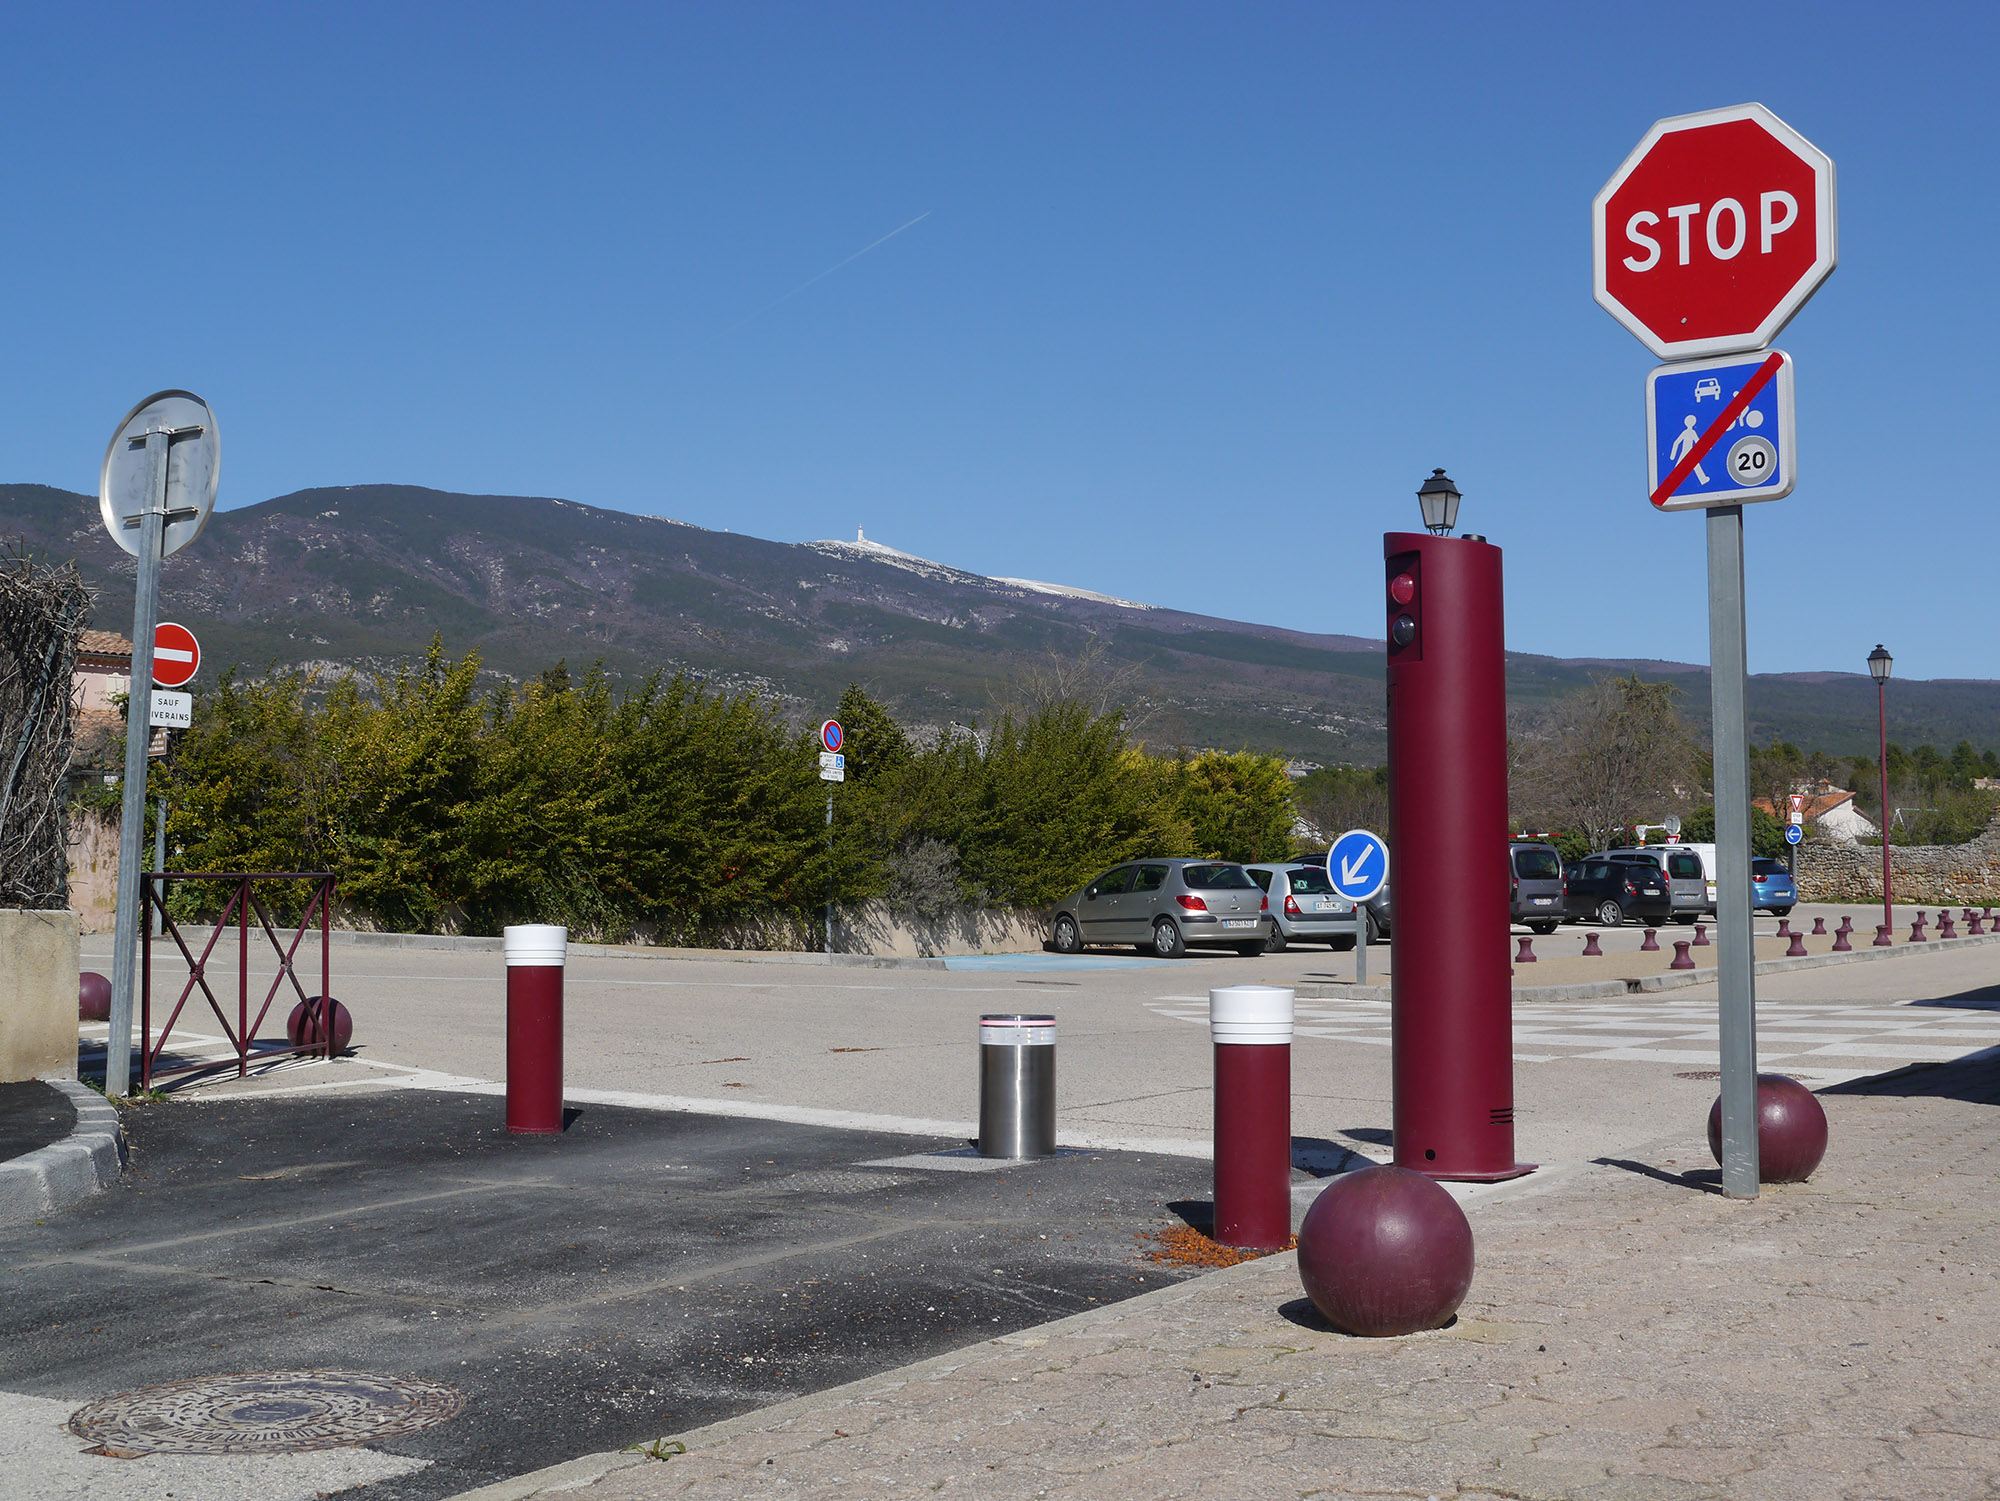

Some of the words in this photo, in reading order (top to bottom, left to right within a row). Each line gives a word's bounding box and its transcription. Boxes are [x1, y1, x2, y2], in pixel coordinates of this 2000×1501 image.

[1622, 190, 1798, 273] STOP
[1738, 451, 1766, 471] 20
[158, 698, 179, 706] SAUF
[151, 711, 189, 721] IVERAINS
